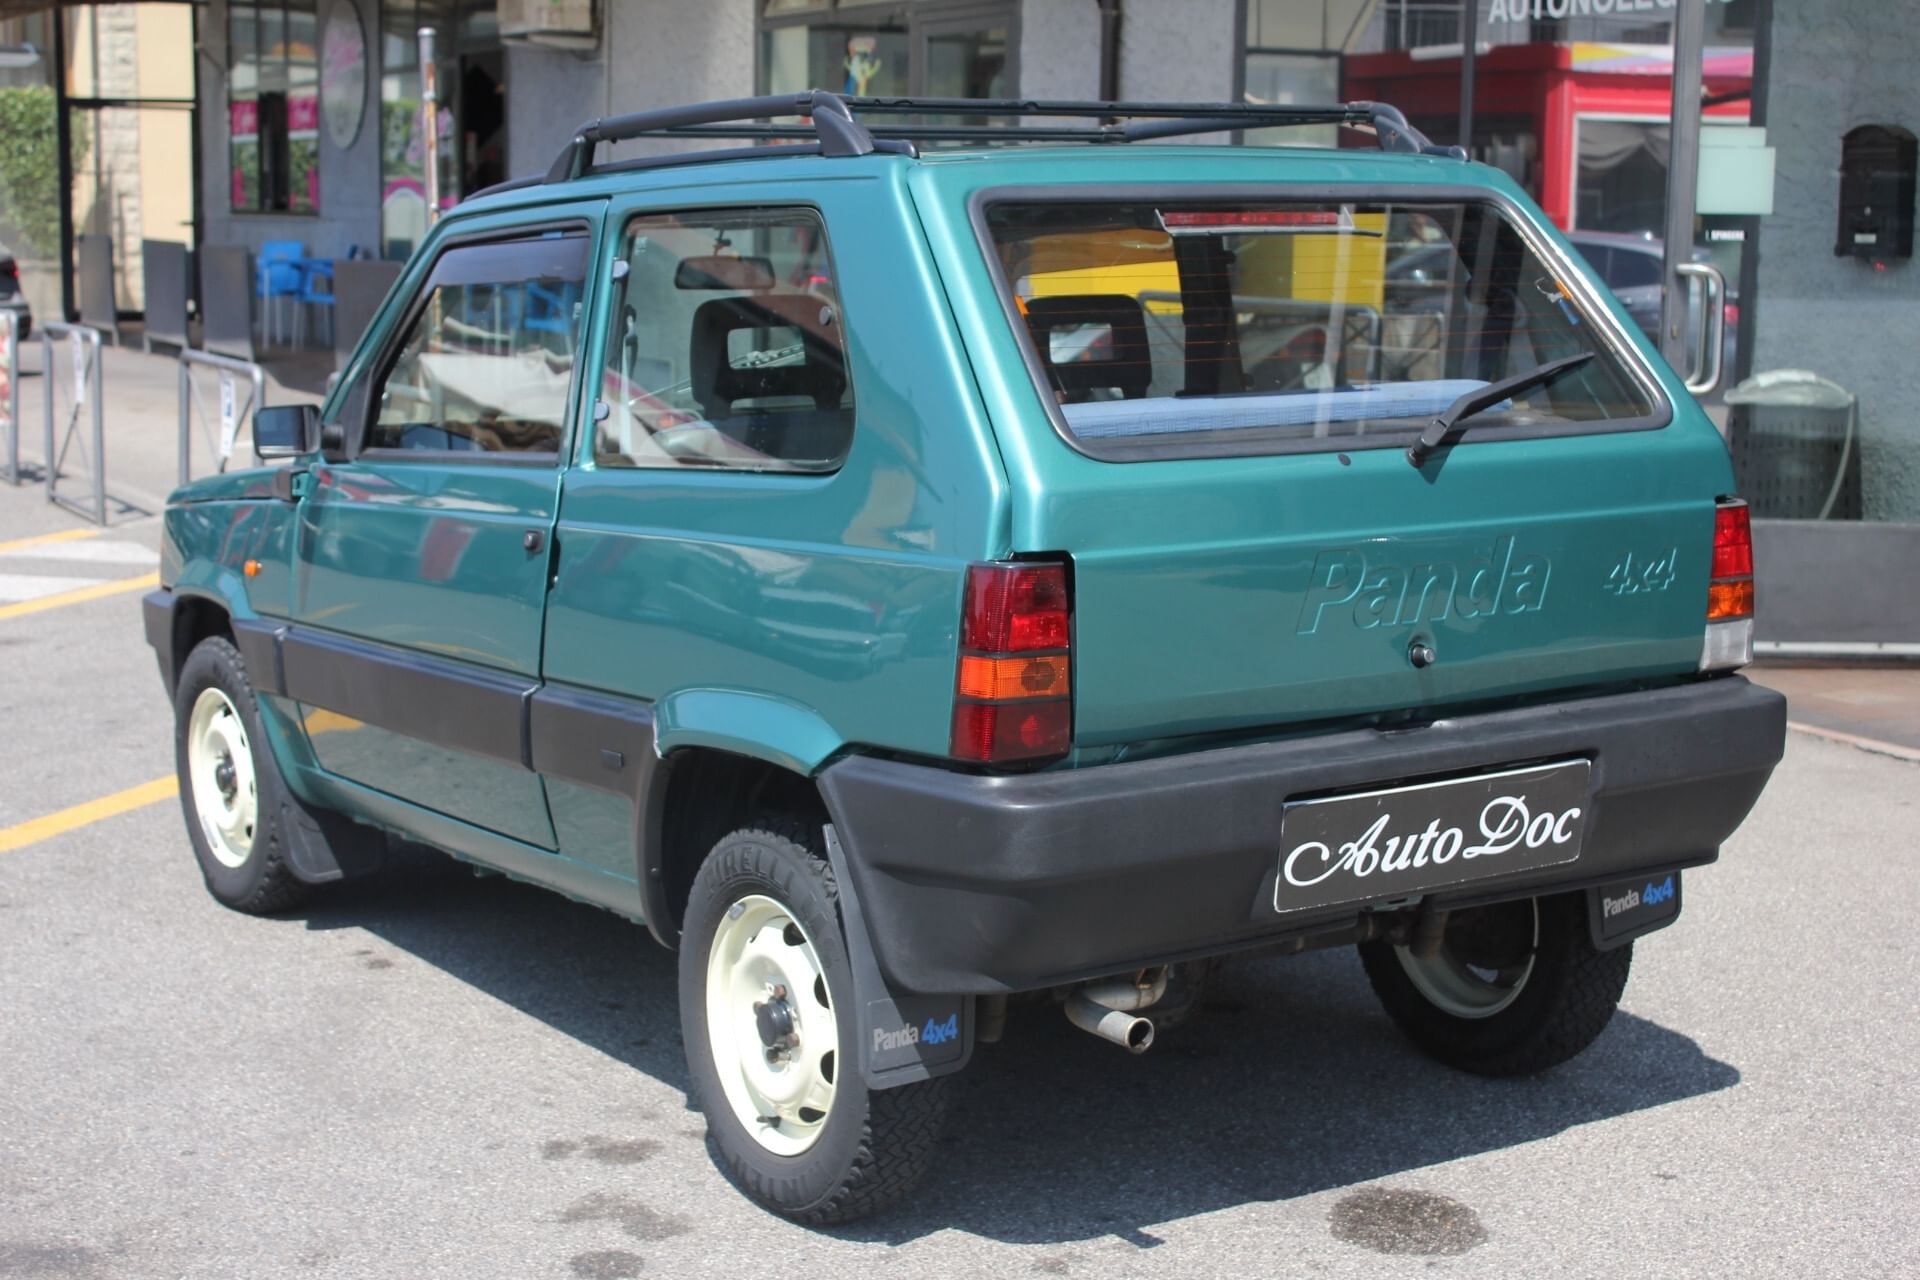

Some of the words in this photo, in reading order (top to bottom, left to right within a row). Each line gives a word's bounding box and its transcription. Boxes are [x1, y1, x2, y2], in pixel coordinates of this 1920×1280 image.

[1296, 535, 1551, 635] Panda
[1603, 547, 1678, 595] 4x4
[1603, 889, 1640, 918] Panda
[1642, 876, 1674, 905] 4x4
[873, 1022, 919, 1053] Panda
[921, 1013, 959, 1045] 4x4
